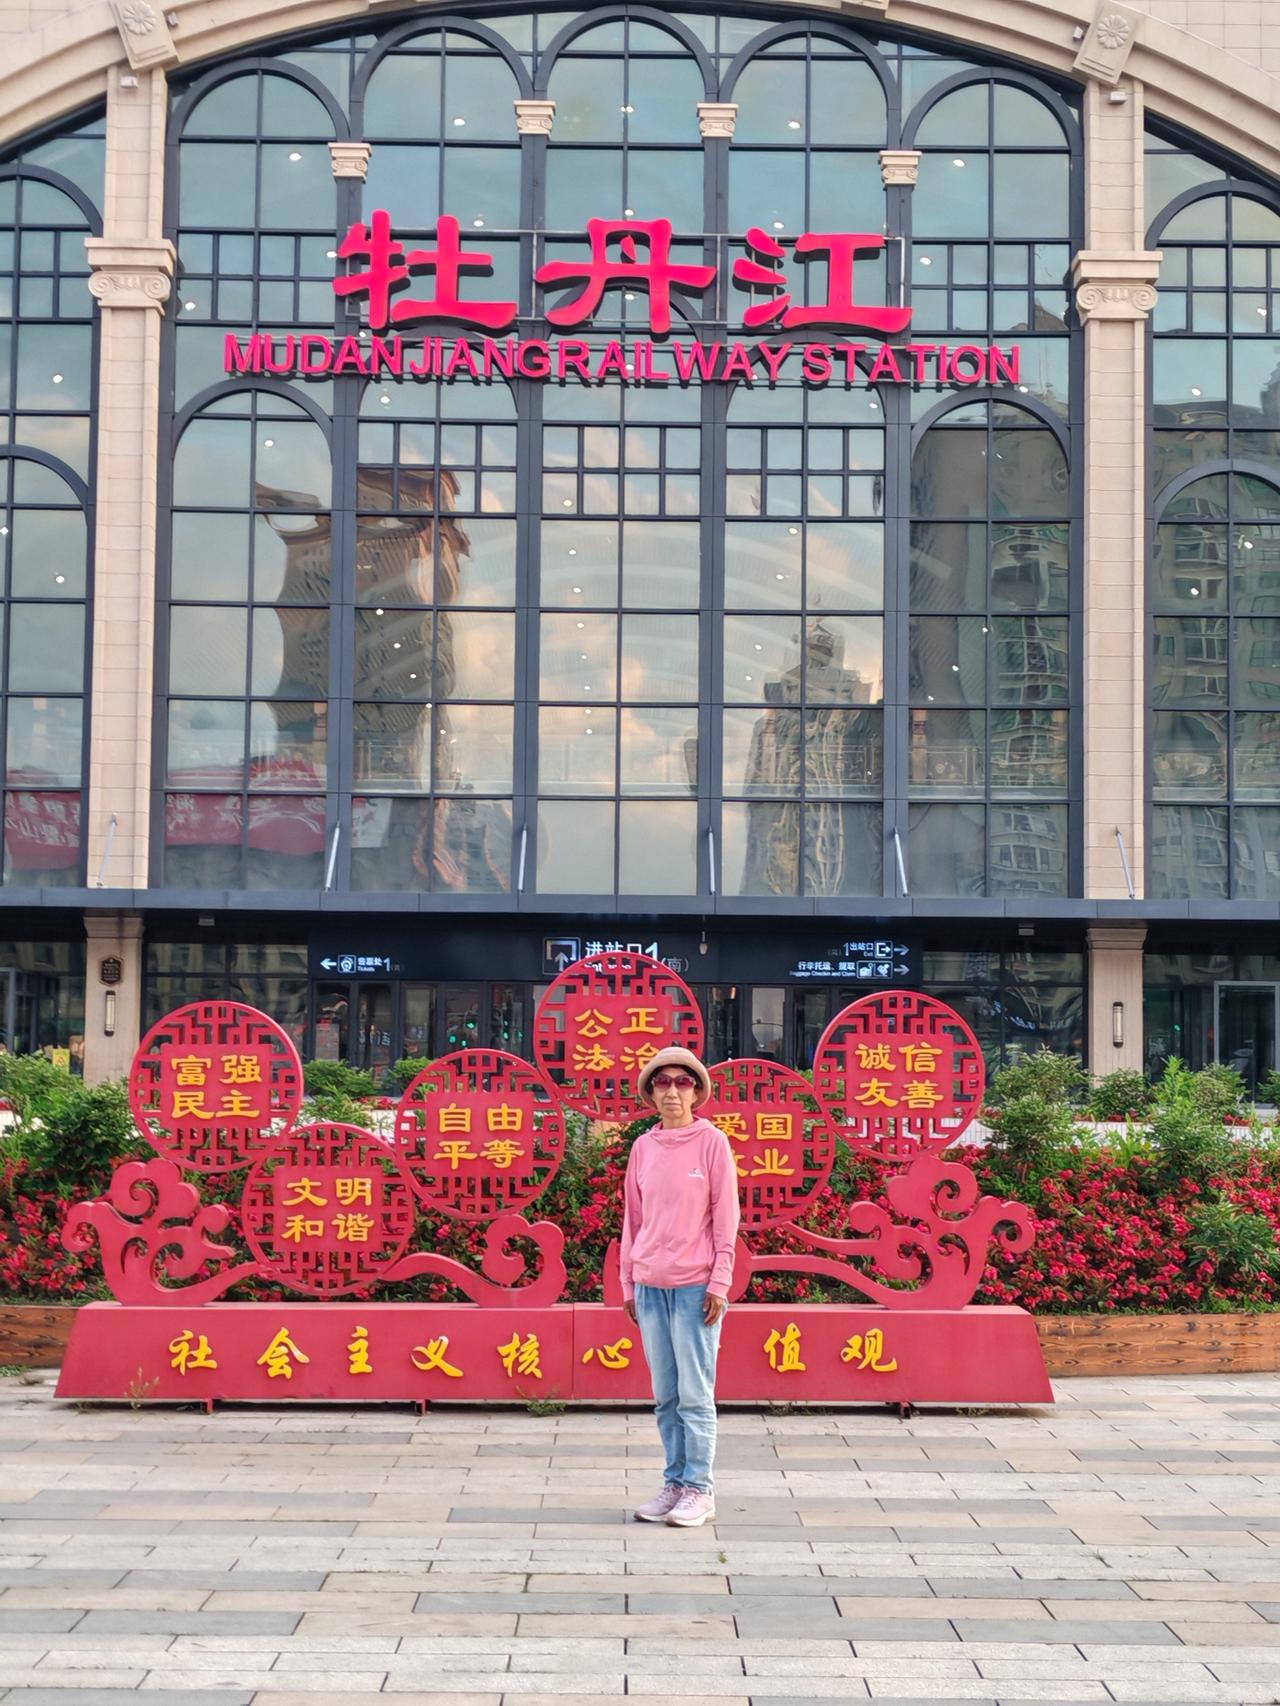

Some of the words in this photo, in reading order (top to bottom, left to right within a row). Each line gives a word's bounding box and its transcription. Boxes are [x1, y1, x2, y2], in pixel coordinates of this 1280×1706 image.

[332, 209, 913, 334] 牡丹江
[802, 343, 1020, 385] STATION
[574, 1007, 665, 1039] 公正
[170, 1054, 263, 1087] 富强
[855, 1042, 943, 1073] 诚信
[171, 1090, 262, 1120] 民主
[855, 1078, 944, 1110] 友善
[437, 1102, 525, 1134] 自由
[712, 1112, 793, 1142] 爱国
[433, 1139, 526, 1171] 平等
[281, 1177, 374, 1208] 文明
[282, 1213, 376, 1244] 和谐
[168, 1322, 898, 1379] 社会主义核心值观
